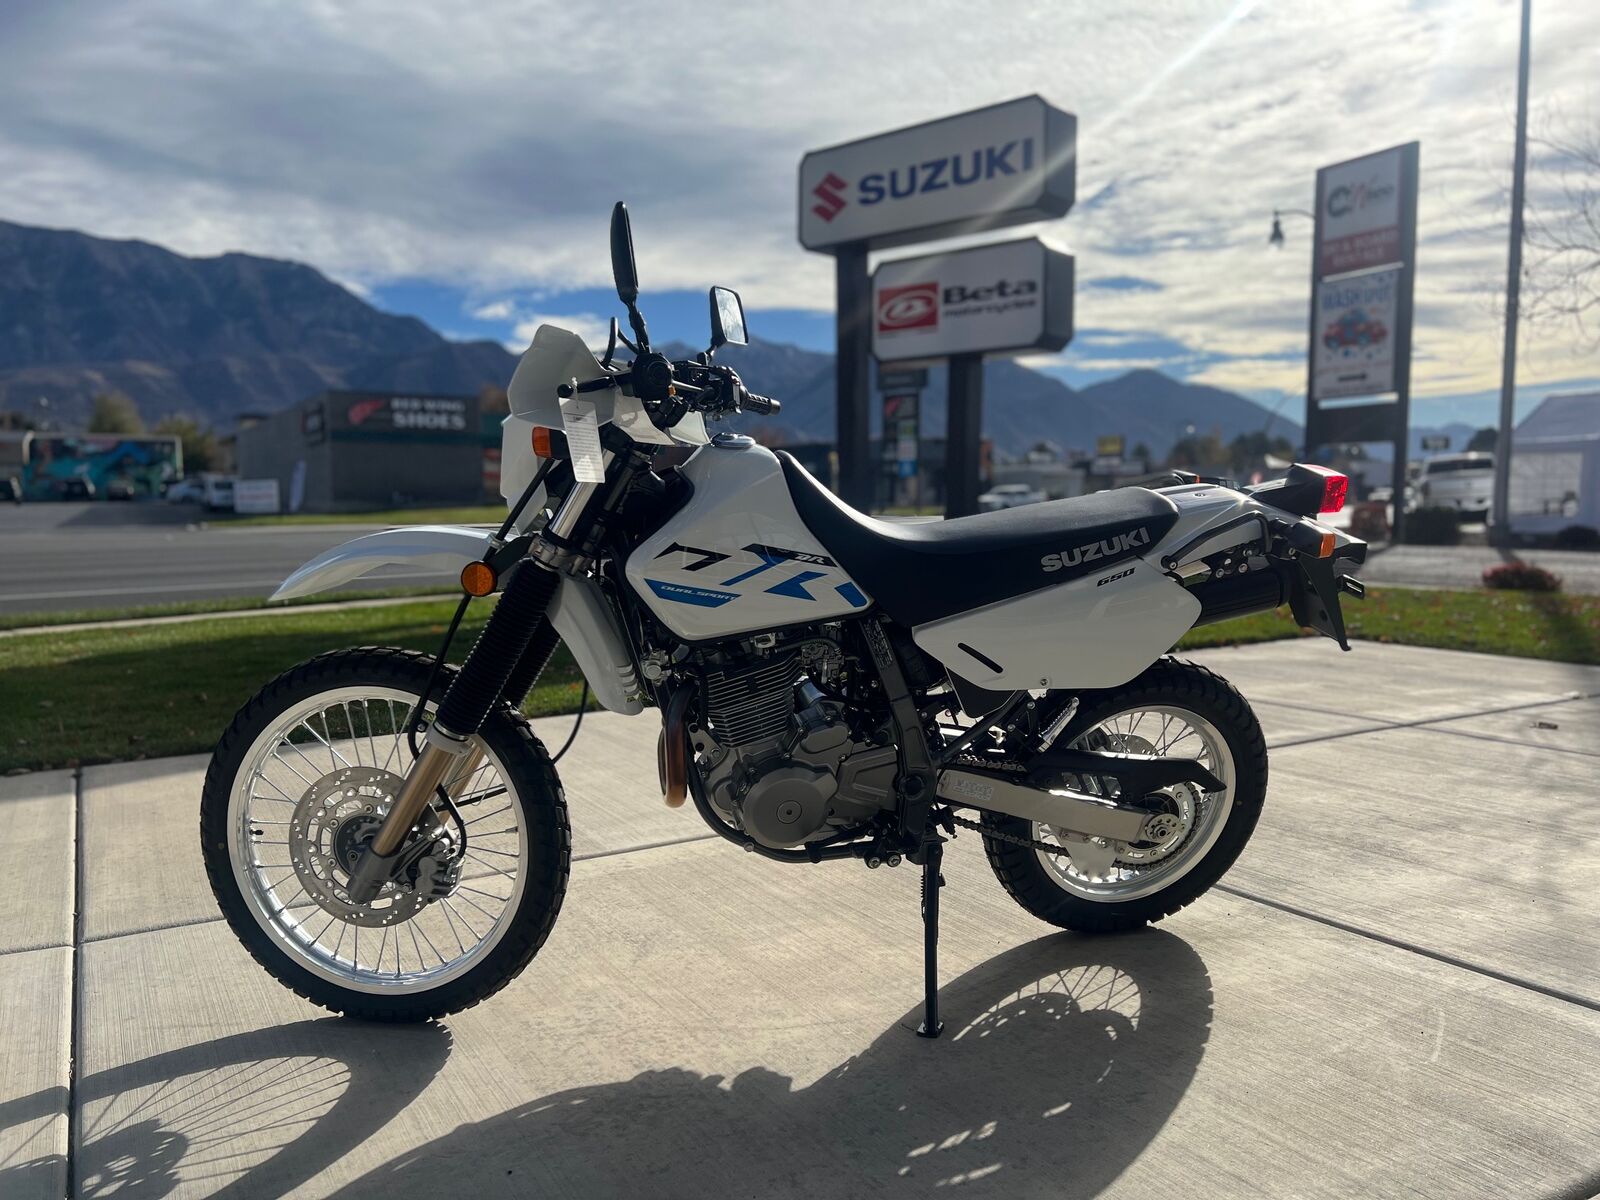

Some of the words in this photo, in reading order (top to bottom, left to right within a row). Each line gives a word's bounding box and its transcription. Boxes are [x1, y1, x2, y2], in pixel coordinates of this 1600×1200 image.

[858, 138, 1035, 206] SUZUKI
[943, 279, 1038, 304] Beta
[392, 412, 466, 429] SHOES
[1040, 527, 1151, 572] SUZUKI
[1097, 567, 1136, 587] 650
